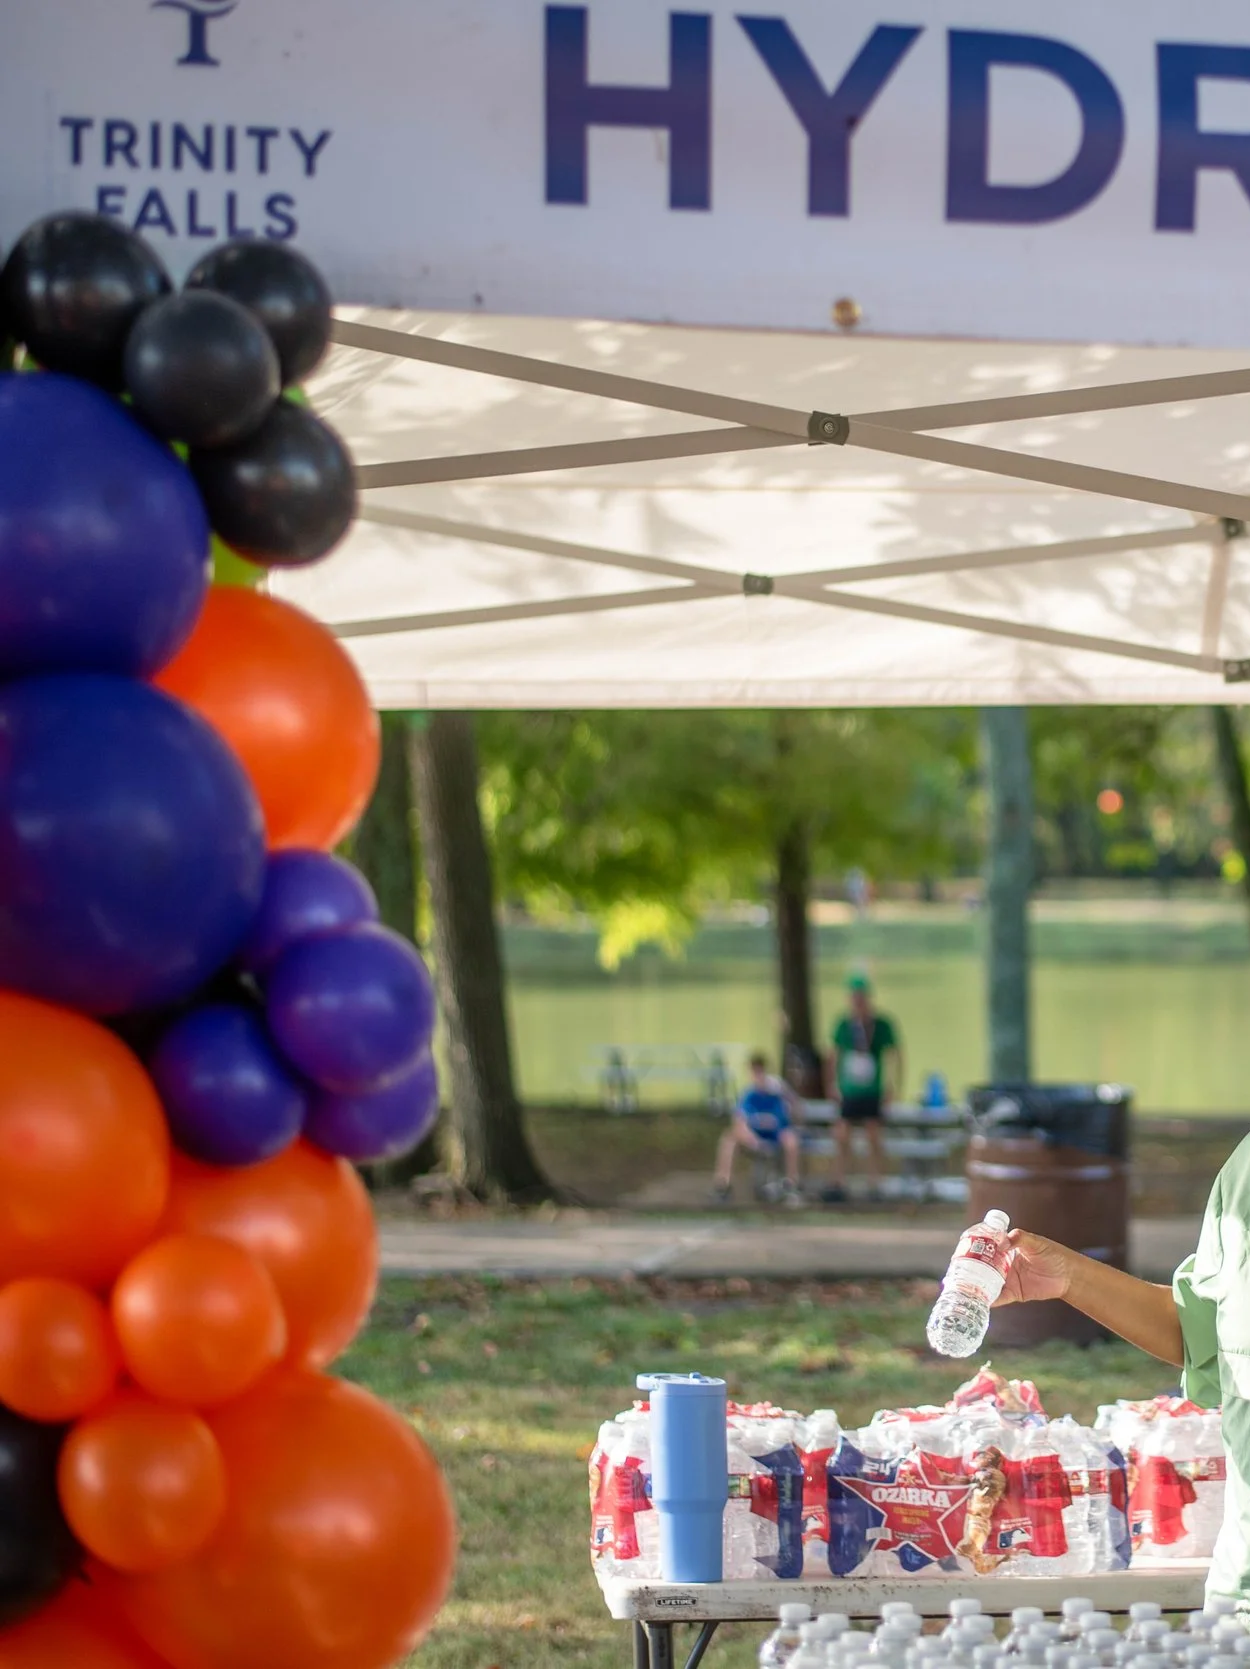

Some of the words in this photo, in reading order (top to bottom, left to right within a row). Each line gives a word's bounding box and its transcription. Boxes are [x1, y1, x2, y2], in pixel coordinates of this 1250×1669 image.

[60, 116, 332, 178] TRINITY
[97, 185, 299, 241] FALLS
[871, 1486, 952, 1508] OZARKA
